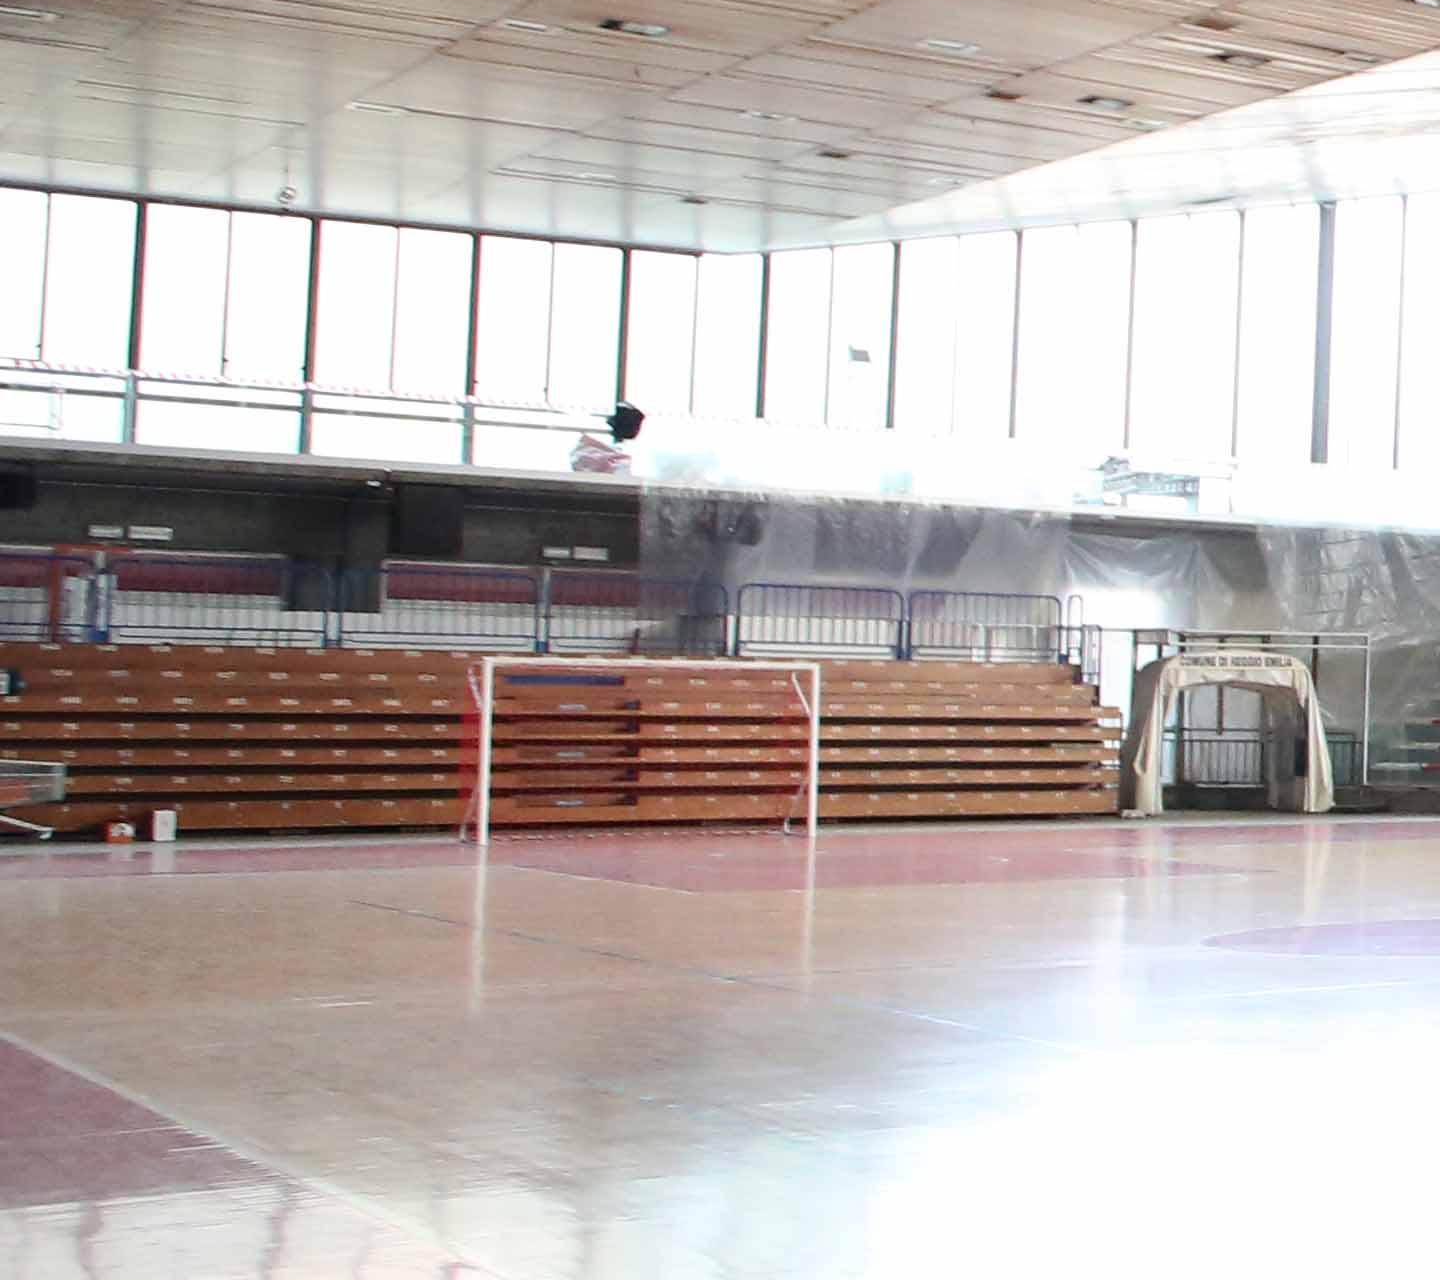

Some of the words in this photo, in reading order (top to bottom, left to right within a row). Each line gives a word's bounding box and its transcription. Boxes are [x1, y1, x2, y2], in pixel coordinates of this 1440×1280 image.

[1180, 655, 1216, 666] COMUNE
[1218, 655, 1228, 666] DI
[1265, 656, 1293, 667] EMILIA
